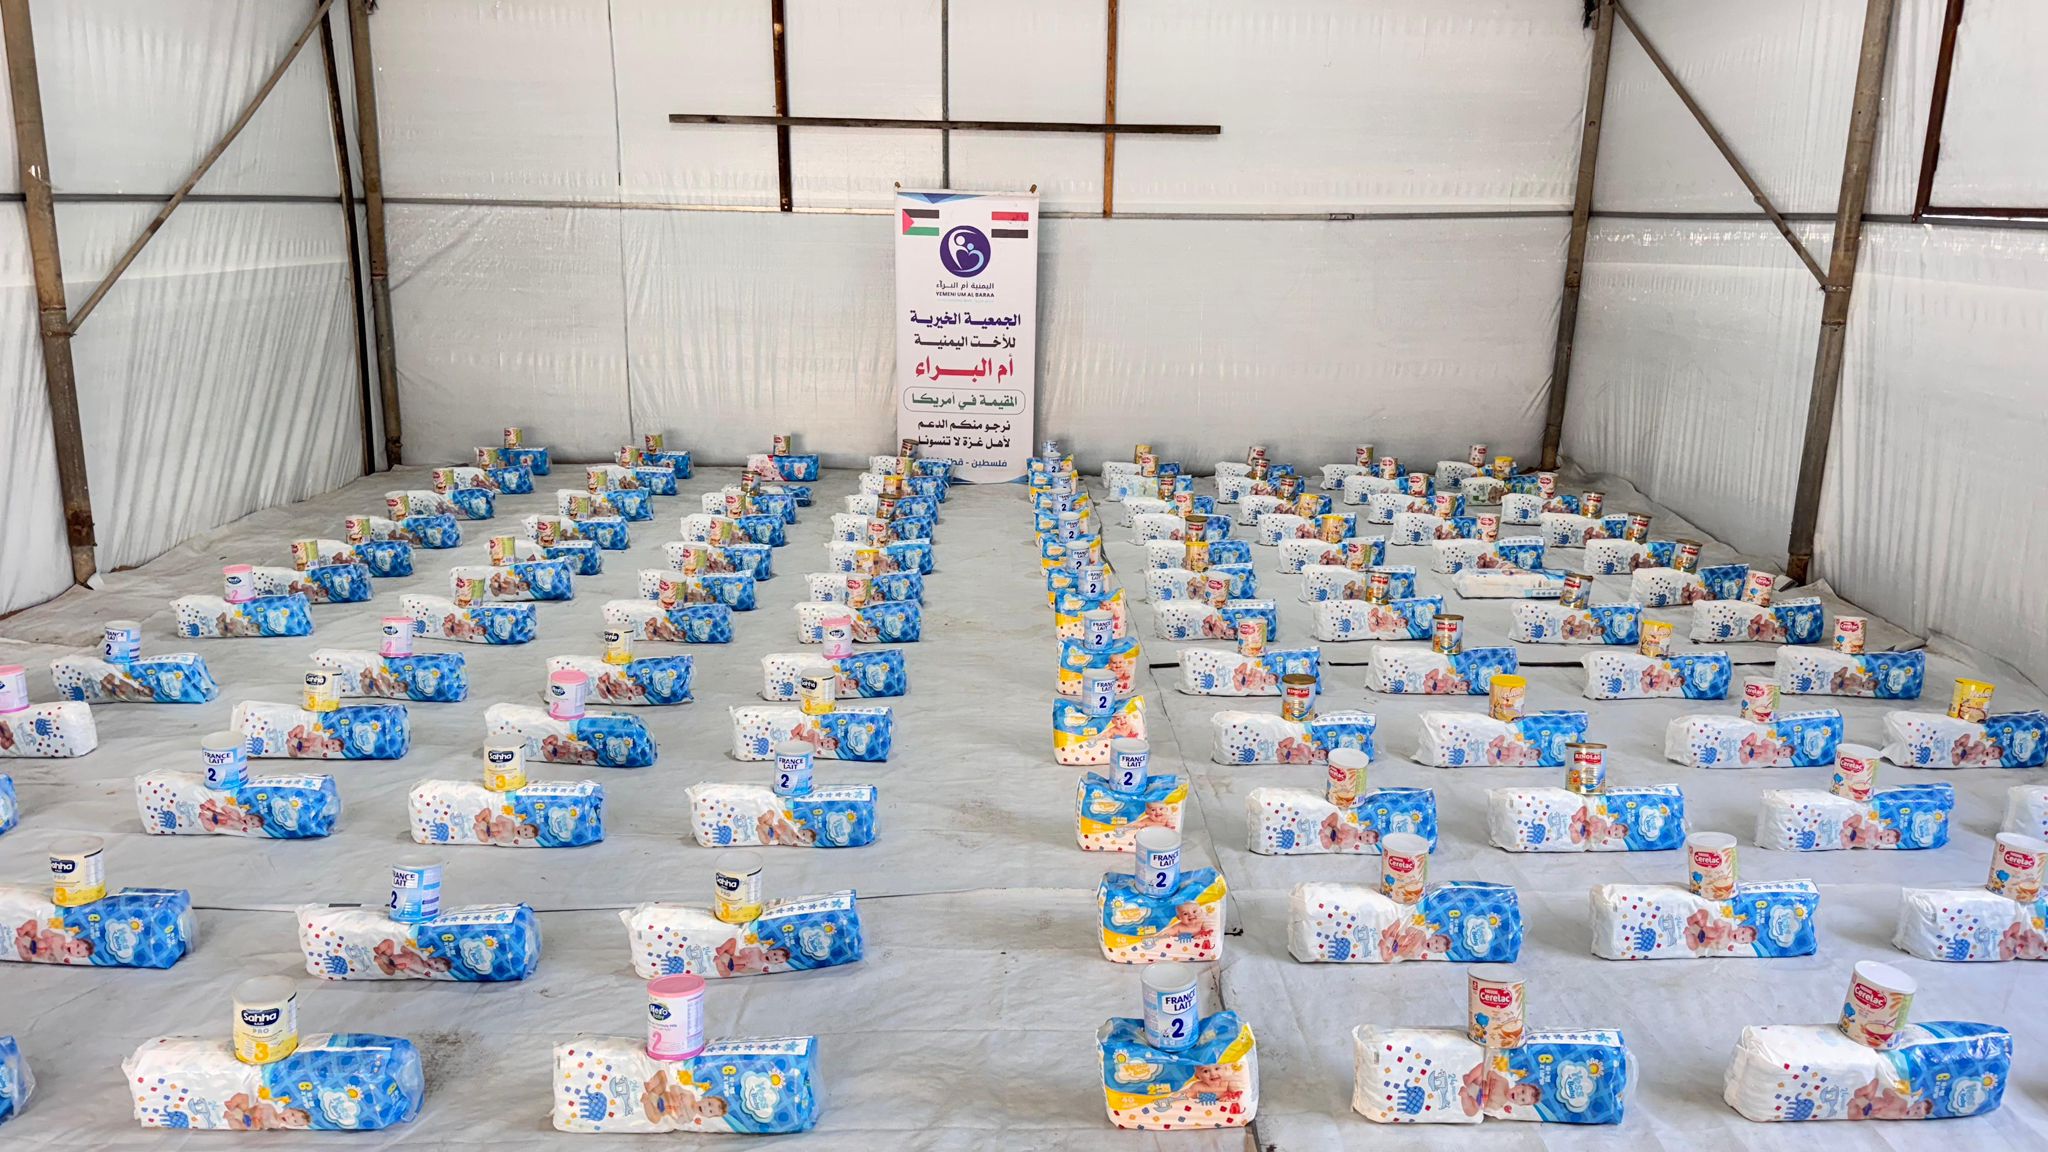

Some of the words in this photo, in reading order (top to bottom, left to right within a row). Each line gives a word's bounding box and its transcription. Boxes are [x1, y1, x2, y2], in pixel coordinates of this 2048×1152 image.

[910, 310, 961, 329] الخيرية
[964, 312, 1020, 330] الجمعية
[914, 334, 968, 350] اليمنية
[970, 333, 1016, 348] للأخت
[916, 356, 992, 382] البراء
[998, 353, 1013, 384] أم
[958, 394, 976, 410] في
[980, 394, 1017, 410] المقيمة
[918, 420, 948, 430] الدعم
[950, 420, 982, 431] منكم
[984, 420, 1010, 433] نرجو
[918, 435, 950, 447] تنسونا
[953, 436, 960, 447] لا
[963, 436, 983, 449] غزة
[986, 436, 1010, 449] لأهل
[971, 459, 1007, 468] فلسطين
[1068, 531, 1074, 539] 2
[1090, 583, 1096, 593] 2
[1096, 634, 1102, 645] 2
[106, 643, 112, 655] 2
[385, 641, 392, 652] 2
[552, 703, 559, 713] 2
[1099, 696, 1107, 708] 2
[490, 752, 512, 760] Sahha
[208, 768, 216, 781] 2
[781, 774, 789, 788] 2
[1124, 772, 1133, 785] 2
[496, 775, 506, 788] 3
[1160, 859, 1174, 867] LAIT
[1694, 854, 1720, 865] Cerelac
[1156, 872, 1167, 888] 2
[56, 887, 67, 903] 3
[391, 890, 397, 909] 2
[722, 902, 730, 920] 3
[1480, 992, 1510, 1002] Cerelac
[1855, 986, 1884, 1006] Cerelac
[650, 1005, 668, 1015] Hero
[1174, 999, 1192, 1011] LAIT
[244, 1012, 277, 1022] Sahha
[1172, 1018, 1184, 1038] 2
[653, 1031, 662, 1051] 2
[255, 1042, 268, 1061] 3
[1568, 1080, 1576, 1099] Baby
